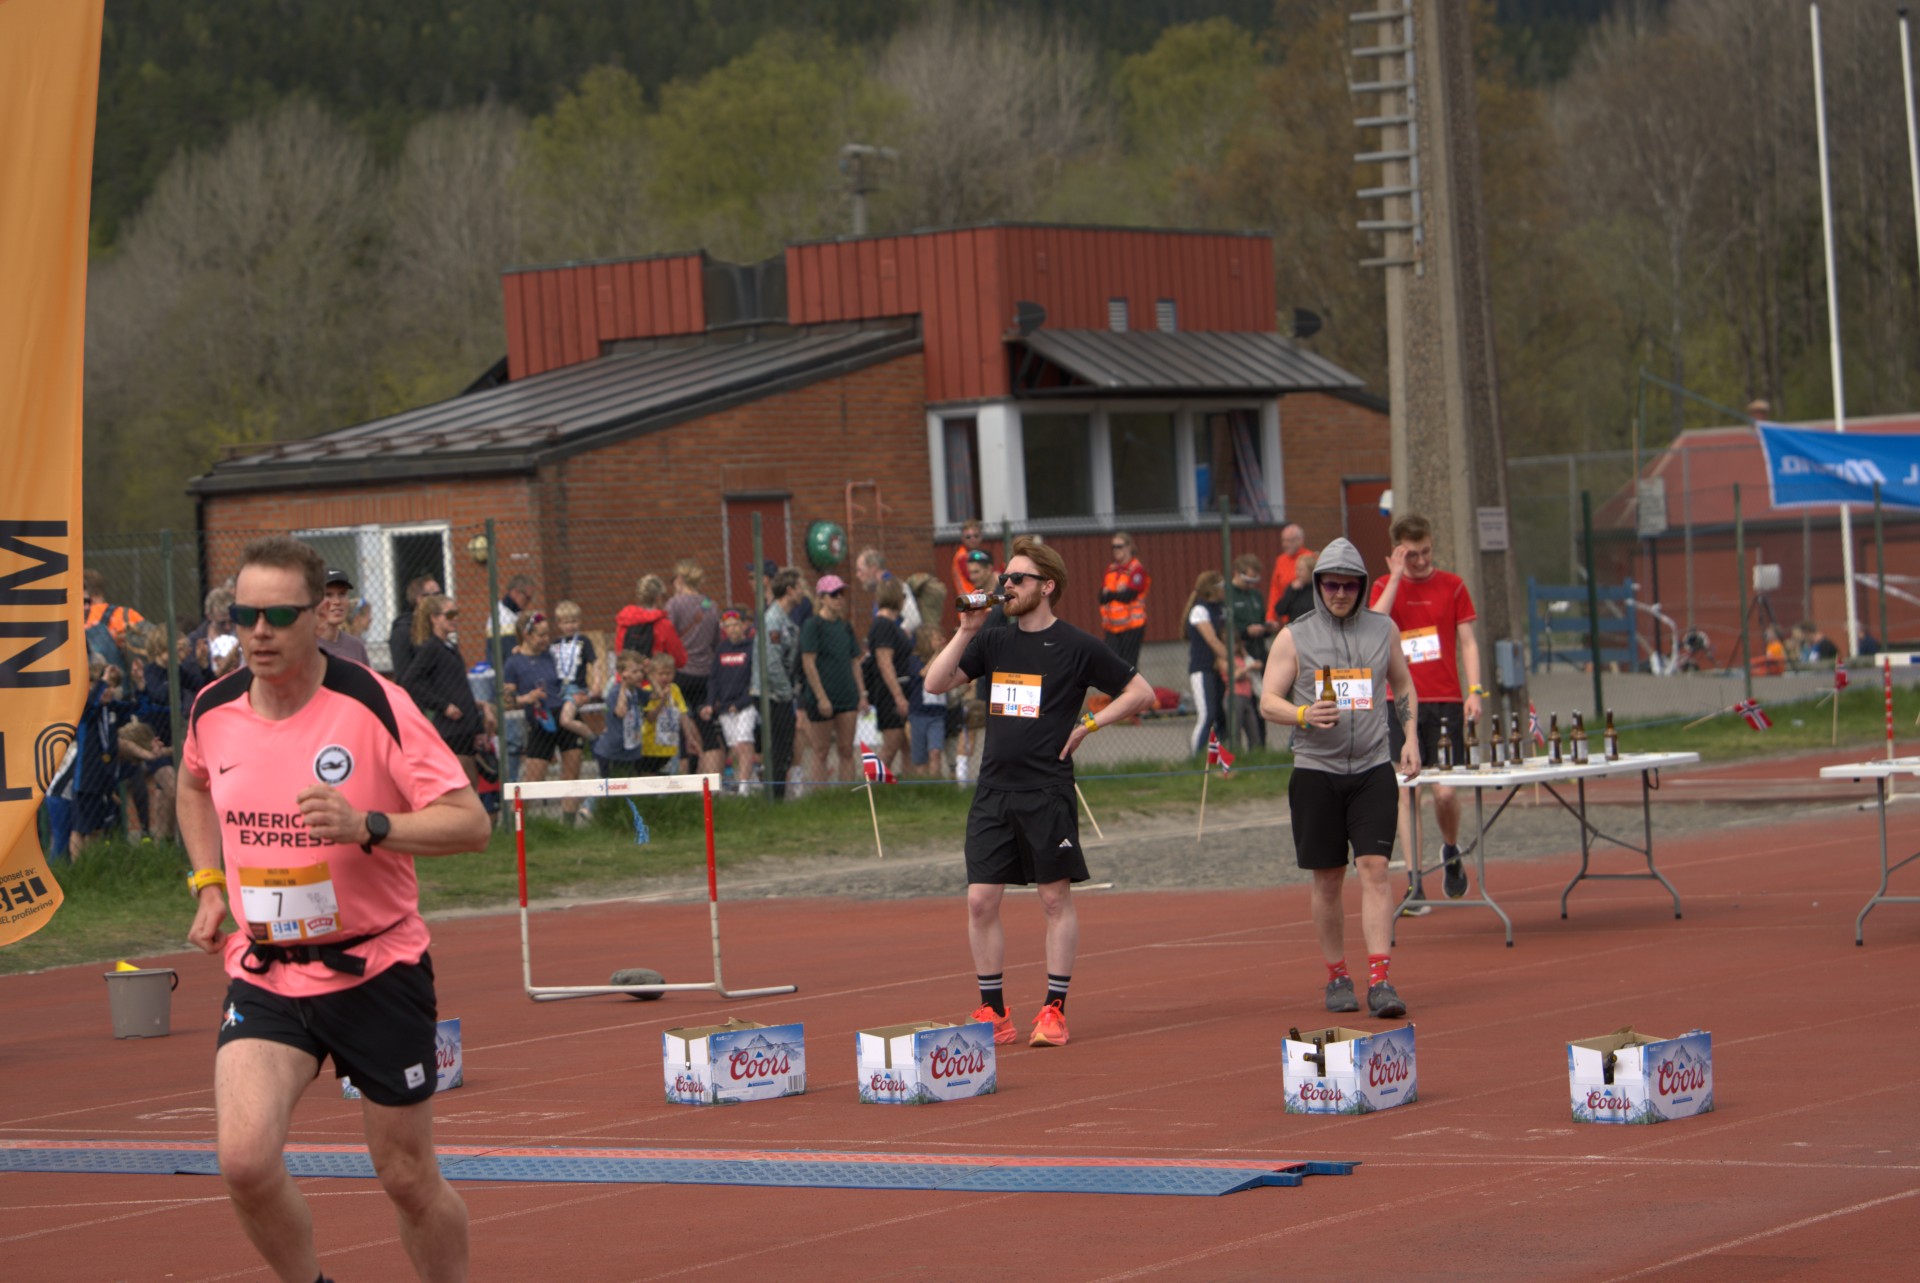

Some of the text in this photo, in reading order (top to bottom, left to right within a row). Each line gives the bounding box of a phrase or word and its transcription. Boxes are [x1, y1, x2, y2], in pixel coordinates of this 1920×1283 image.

[1006, 687, 1017, 702] 11
[1336, 681, 1349, 697] 12
[226, 810, 305, 829] AMERIC
[12, 898, 54, 924] profilering
[271, 892, 283, 918] 7
[436, 1044, 455, 1070] ors
[729, 1051, 791, 1080] Coors
[930, 1047, 985, 1080] Coors
[1368, 1053, 1409, 1088] Coors
[1657, 1060, 1705, 1096] Coors
[675, 1075, 704, 1094] Coors
[870, 1073, 906, 1092] Coors
[1299, 1082, 1343, 1101] Coors
[1586, 1090, 1631, 1110] Coors
